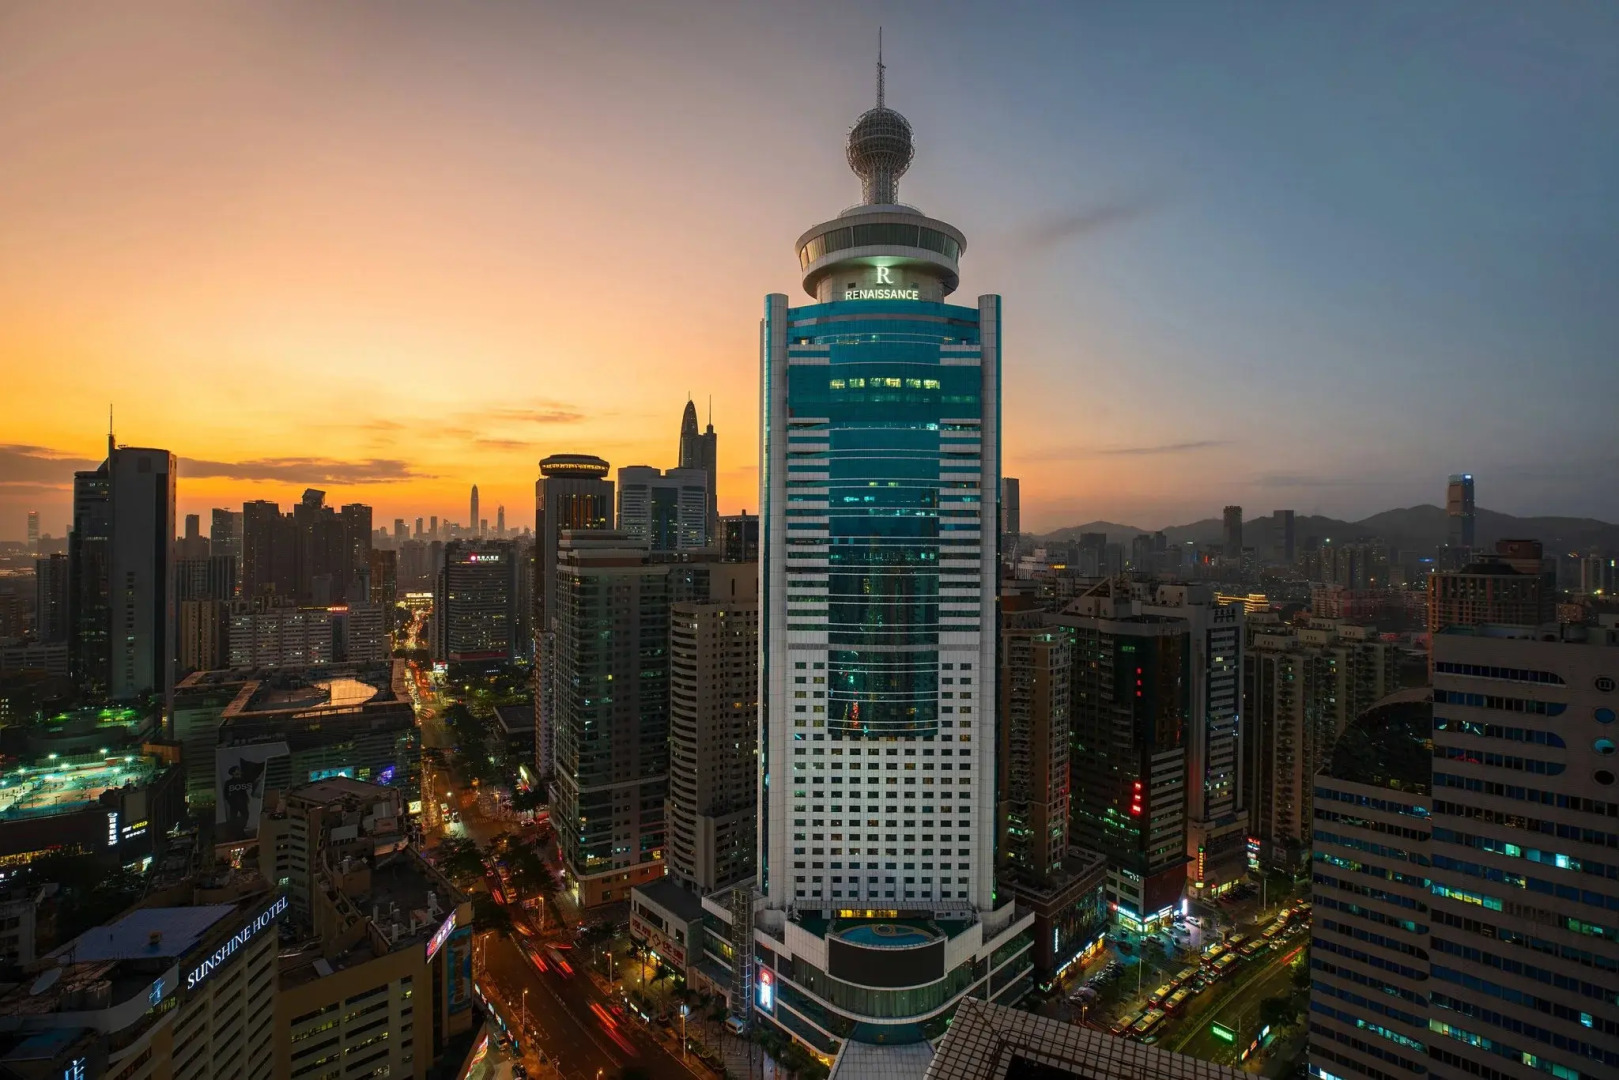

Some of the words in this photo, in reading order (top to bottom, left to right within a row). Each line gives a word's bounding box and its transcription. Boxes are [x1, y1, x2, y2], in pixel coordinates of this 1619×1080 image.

[845, 289, 919, 300] RENAISSANCE
[229, 783, 253, 792] BOSS
[187, 925, 251, 990] SUNSHINE
[253, 896, 289, 934] HOTEL
